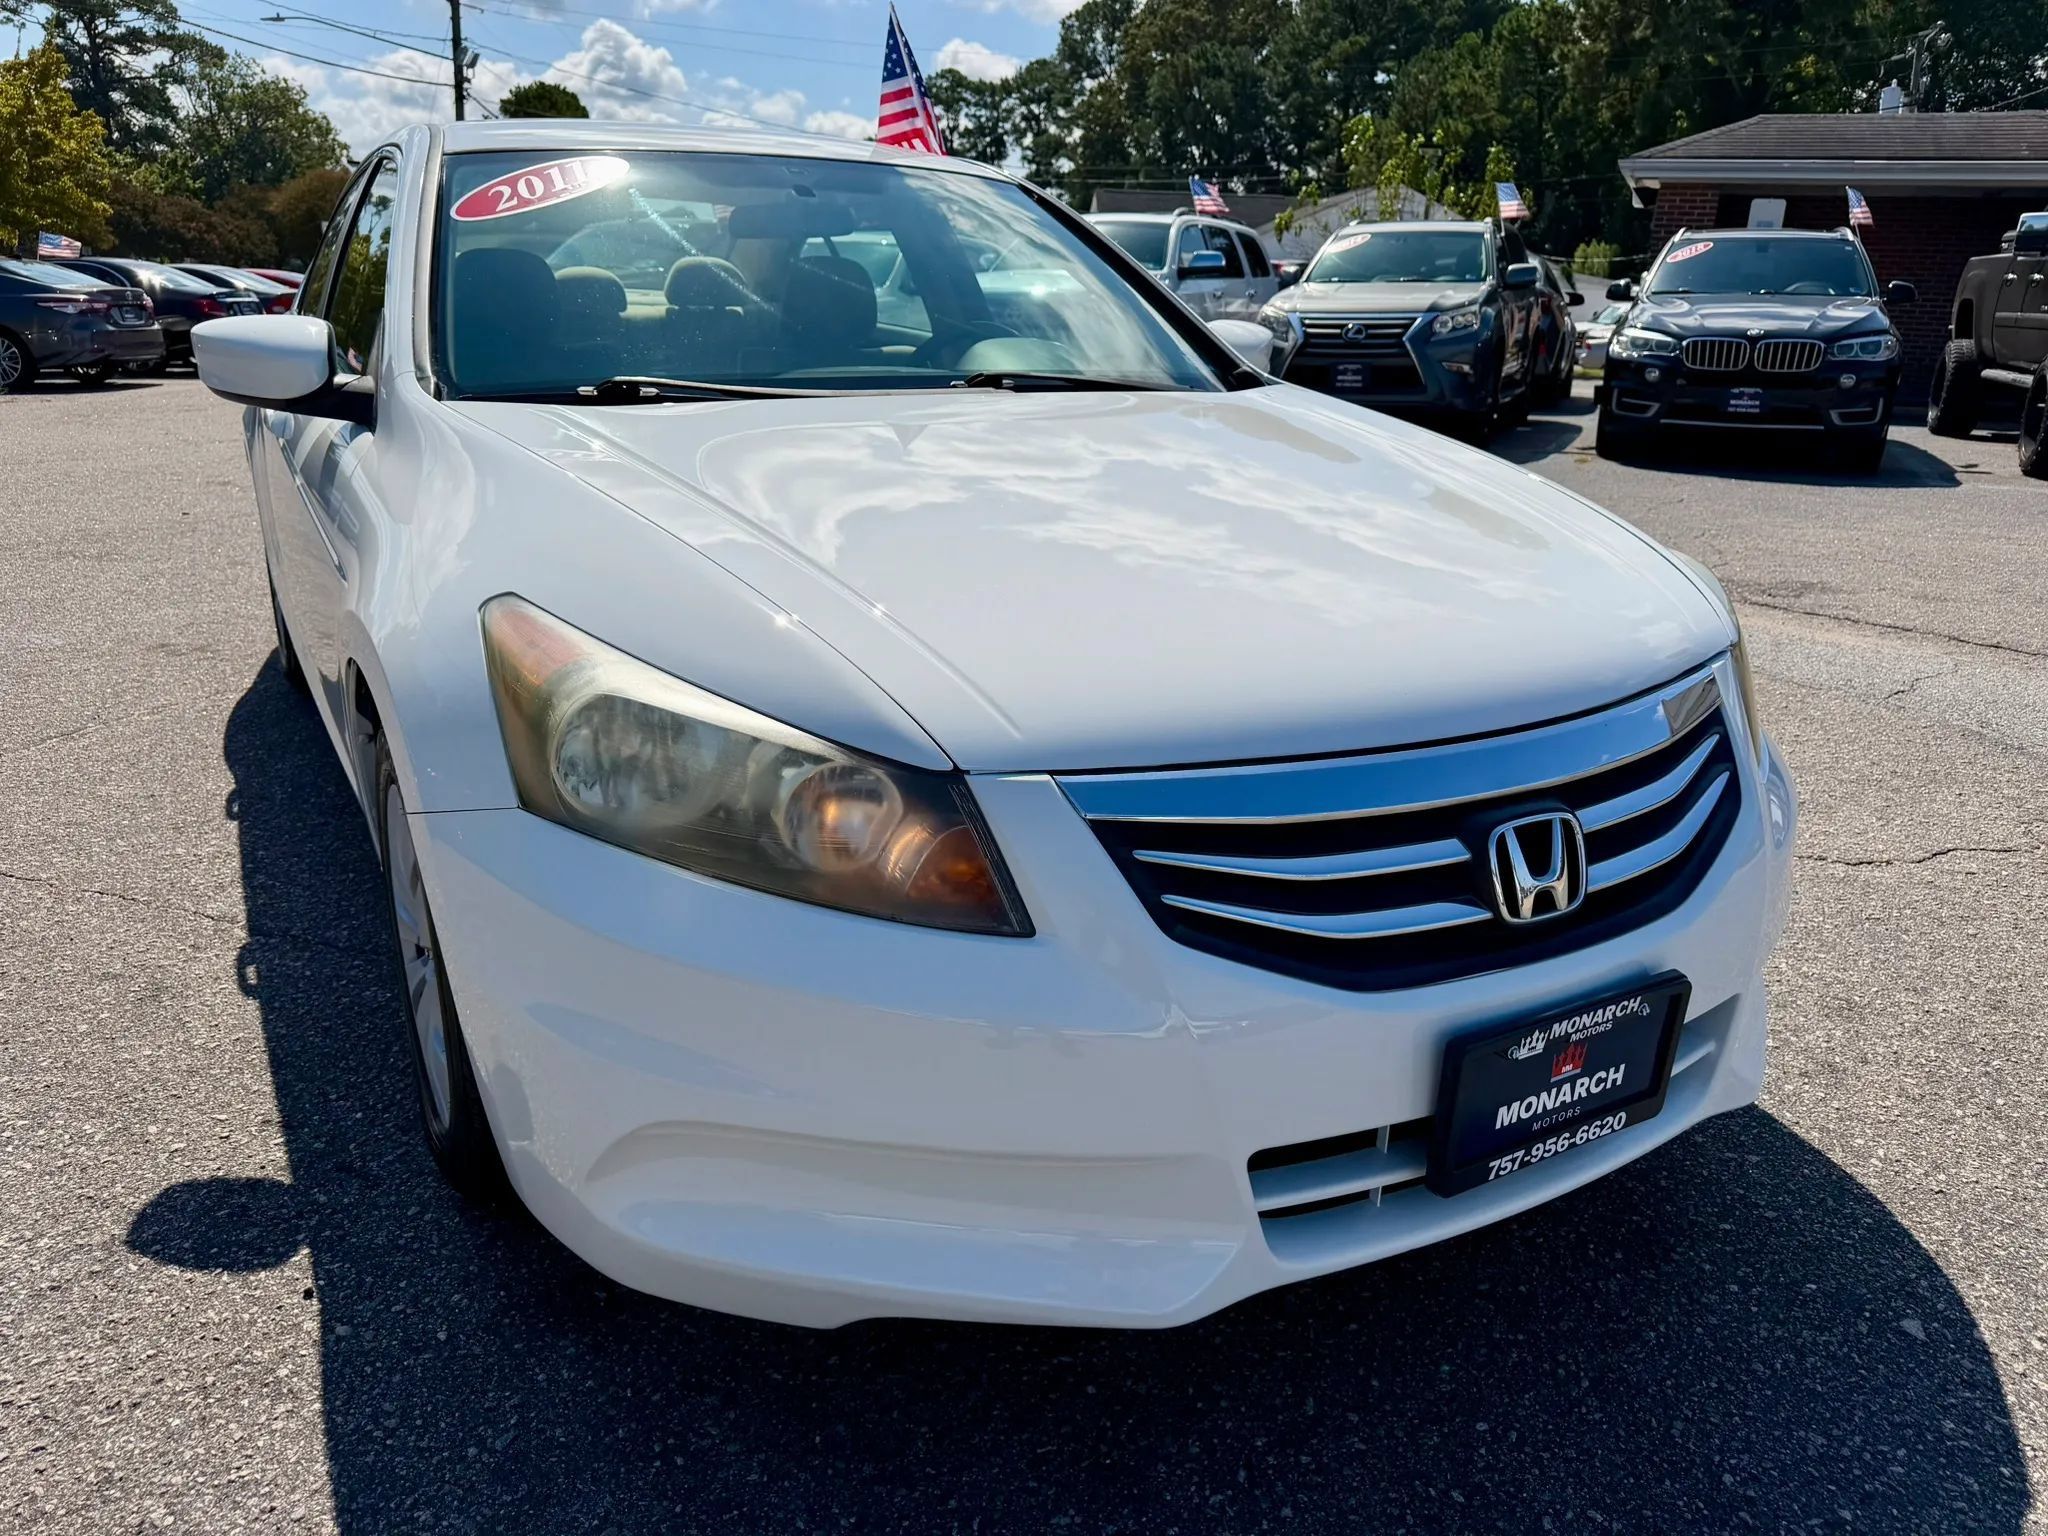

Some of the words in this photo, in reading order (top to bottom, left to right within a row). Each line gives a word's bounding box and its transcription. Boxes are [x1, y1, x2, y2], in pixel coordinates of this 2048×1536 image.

[1549, 996, 1642, 1040] MONARCH
[1569, 1021, 1613, 1043] MOTORS
[1495, 1063, 1626, 1130] MONARCH
[1532, 1106, 1581, 1132] MOTORS
[1488, 1111, 1627, 1181] 757-956-6620
